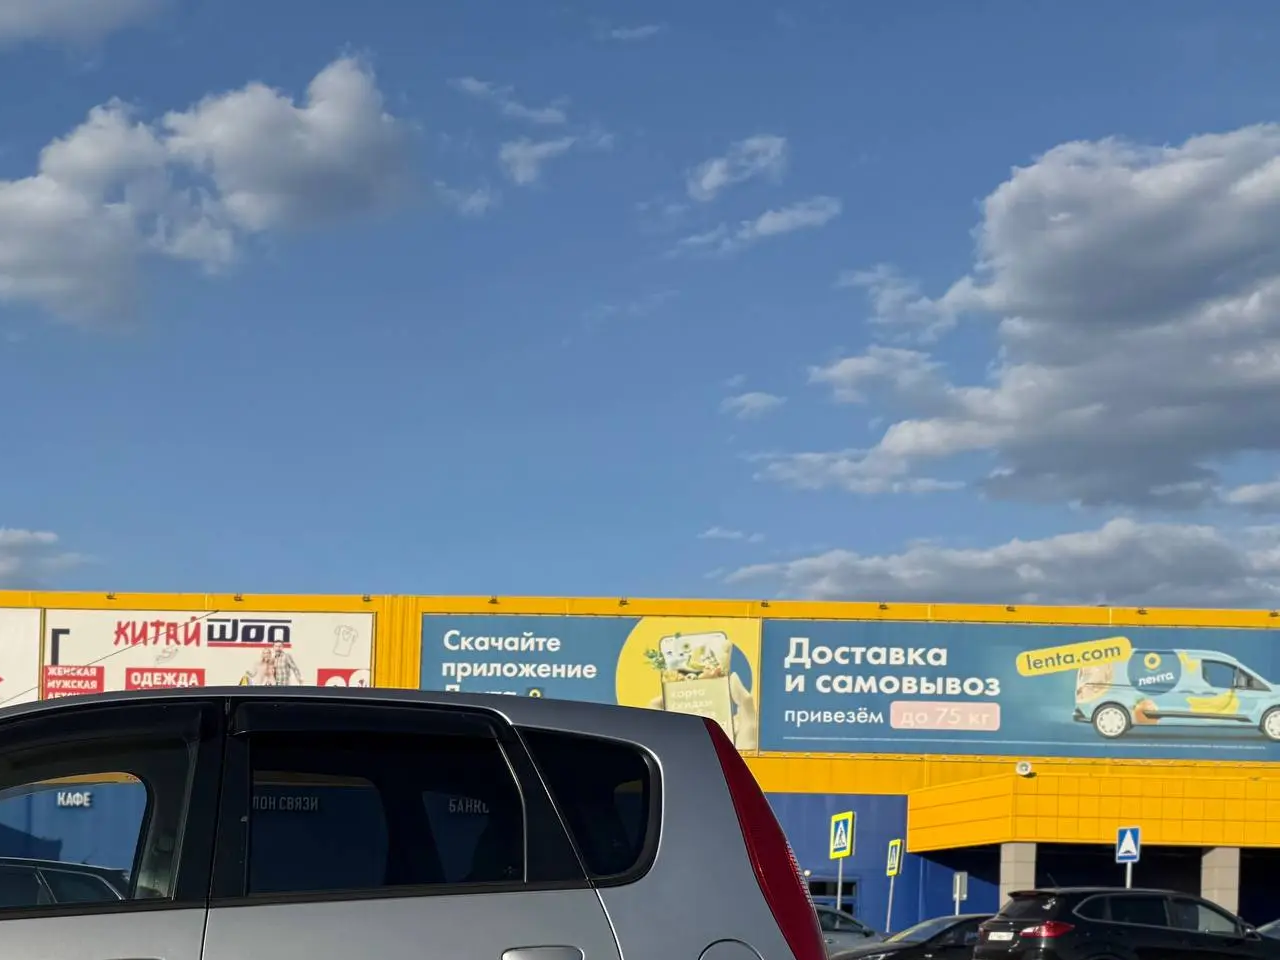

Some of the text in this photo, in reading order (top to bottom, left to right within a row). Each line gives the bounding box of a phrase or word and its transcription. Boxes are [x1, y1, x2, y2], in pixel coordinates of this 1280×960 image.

[113, 616, 202, 647] КИТАЙ
[443, 630, 562, 652] Скачайте
[784, 637, 948, 669] Доставка
[1026, 645, 1122, 671] lenta.com
[47, 667, 98, 677] ЖЕНСКАЯ
[131, 672, 200, 687] ОДЕЖДА
[442, 660, 598, 686] приложение
[1138, 672, 1175, 687] лента
[47, 679, 99, 689] МУЖСКАЯ
[785, 674, 1001, 696] и самовывоз
[785, 706, 991, 727] привезём до 75 кг
[56, 791, 91, 807] КАФЕ
[279, 796, 319, 811] СВЯЗИ
